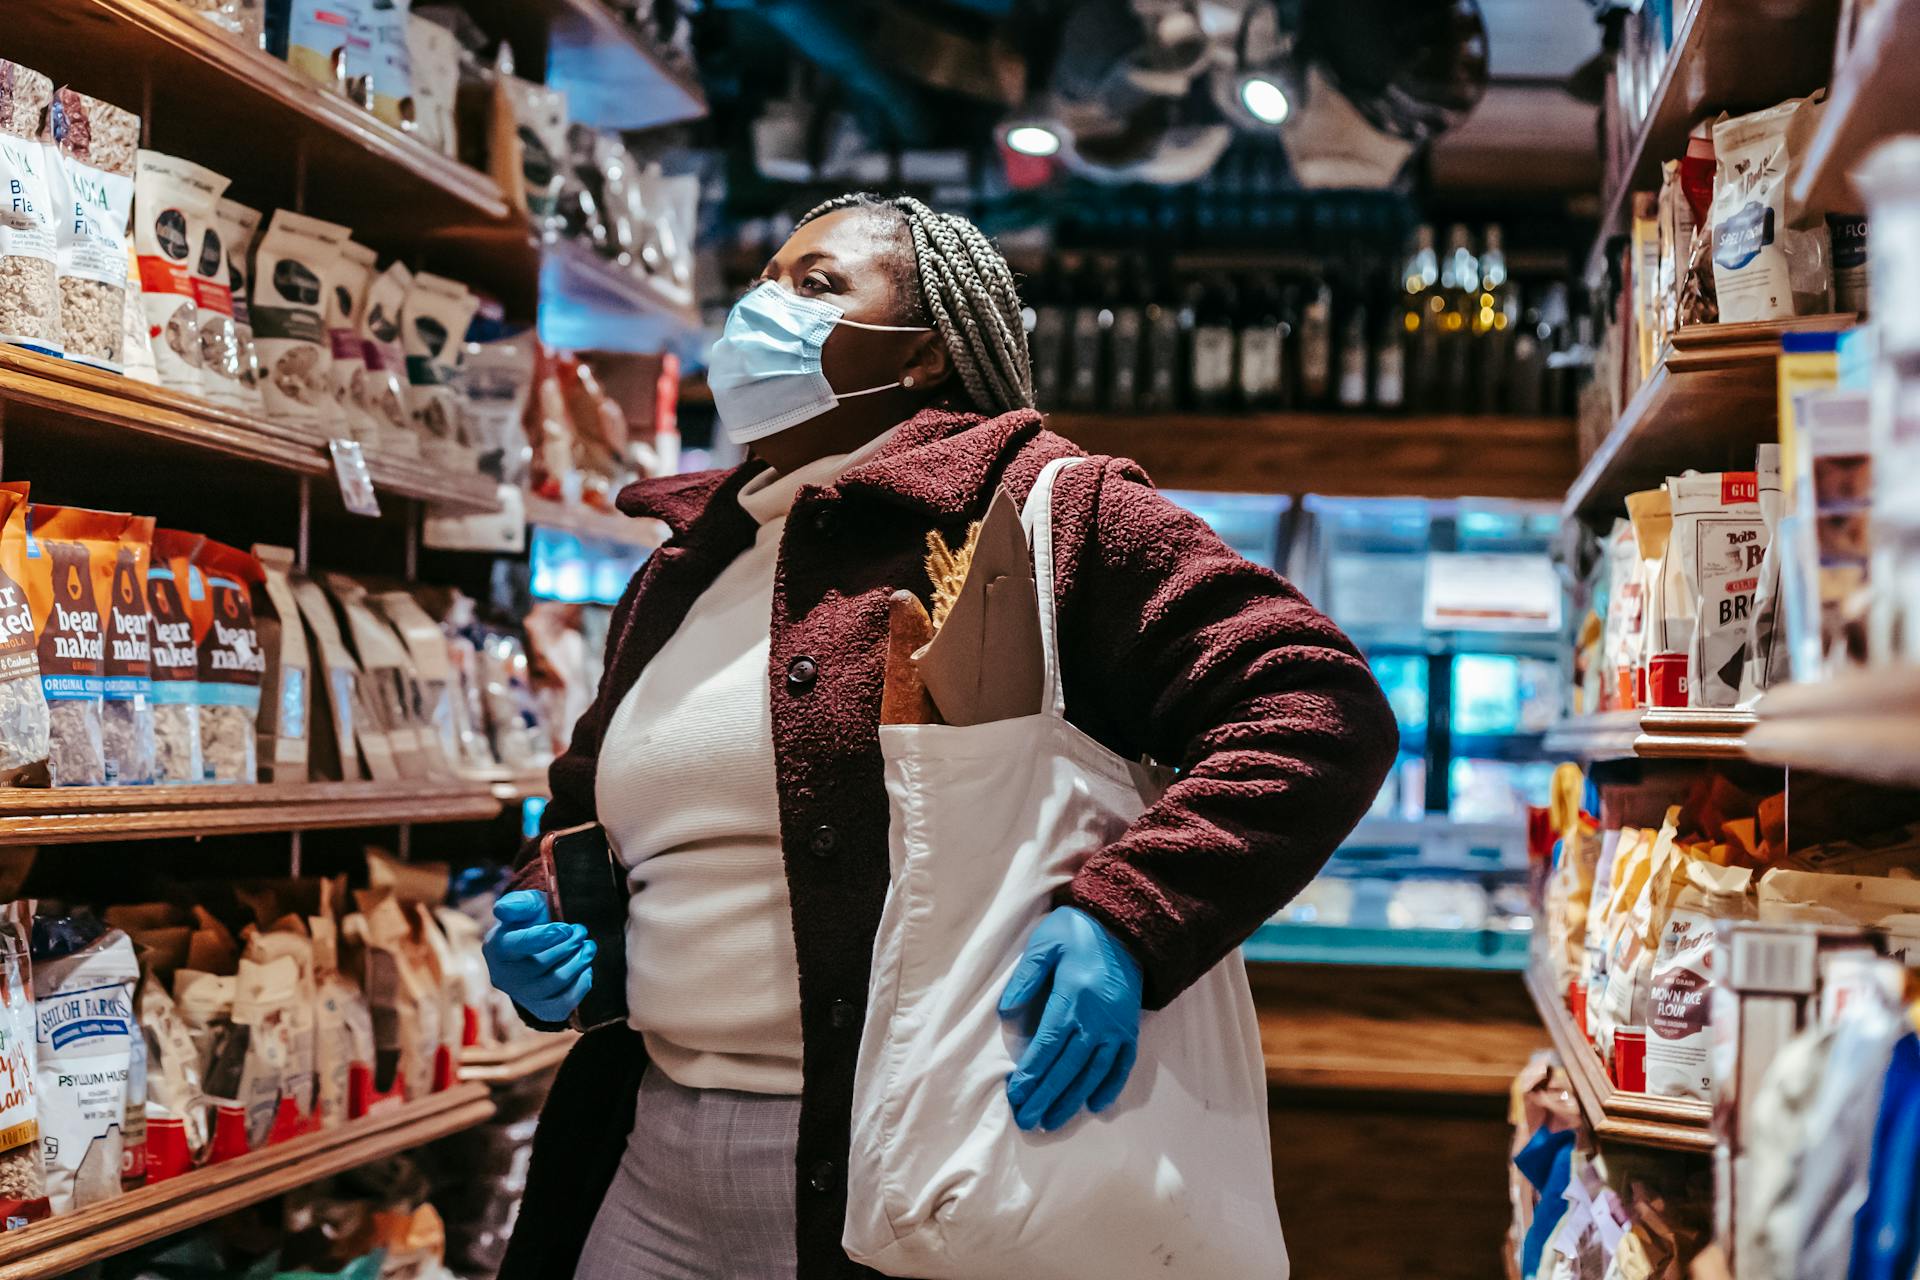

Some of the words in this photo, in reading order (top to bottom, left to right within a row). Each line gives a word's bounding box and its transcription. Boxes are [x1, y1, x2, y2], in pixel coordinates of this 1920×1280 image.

[1731, 484, 1755, 498] GLU
[1726, 531, 1757, 545] Bob's
[55, 603, 98, 632] bear
[113, 606, 148, 634] bear
[54, 630, 104, 660] naked
[44, 678, 84, 692] ORIGINAL
[1682, 991, 1703, 1005] RICE
[41, 1000, 81, 1034] SHILOH
[1657, 1002, 1686, 1018] FLOUR
